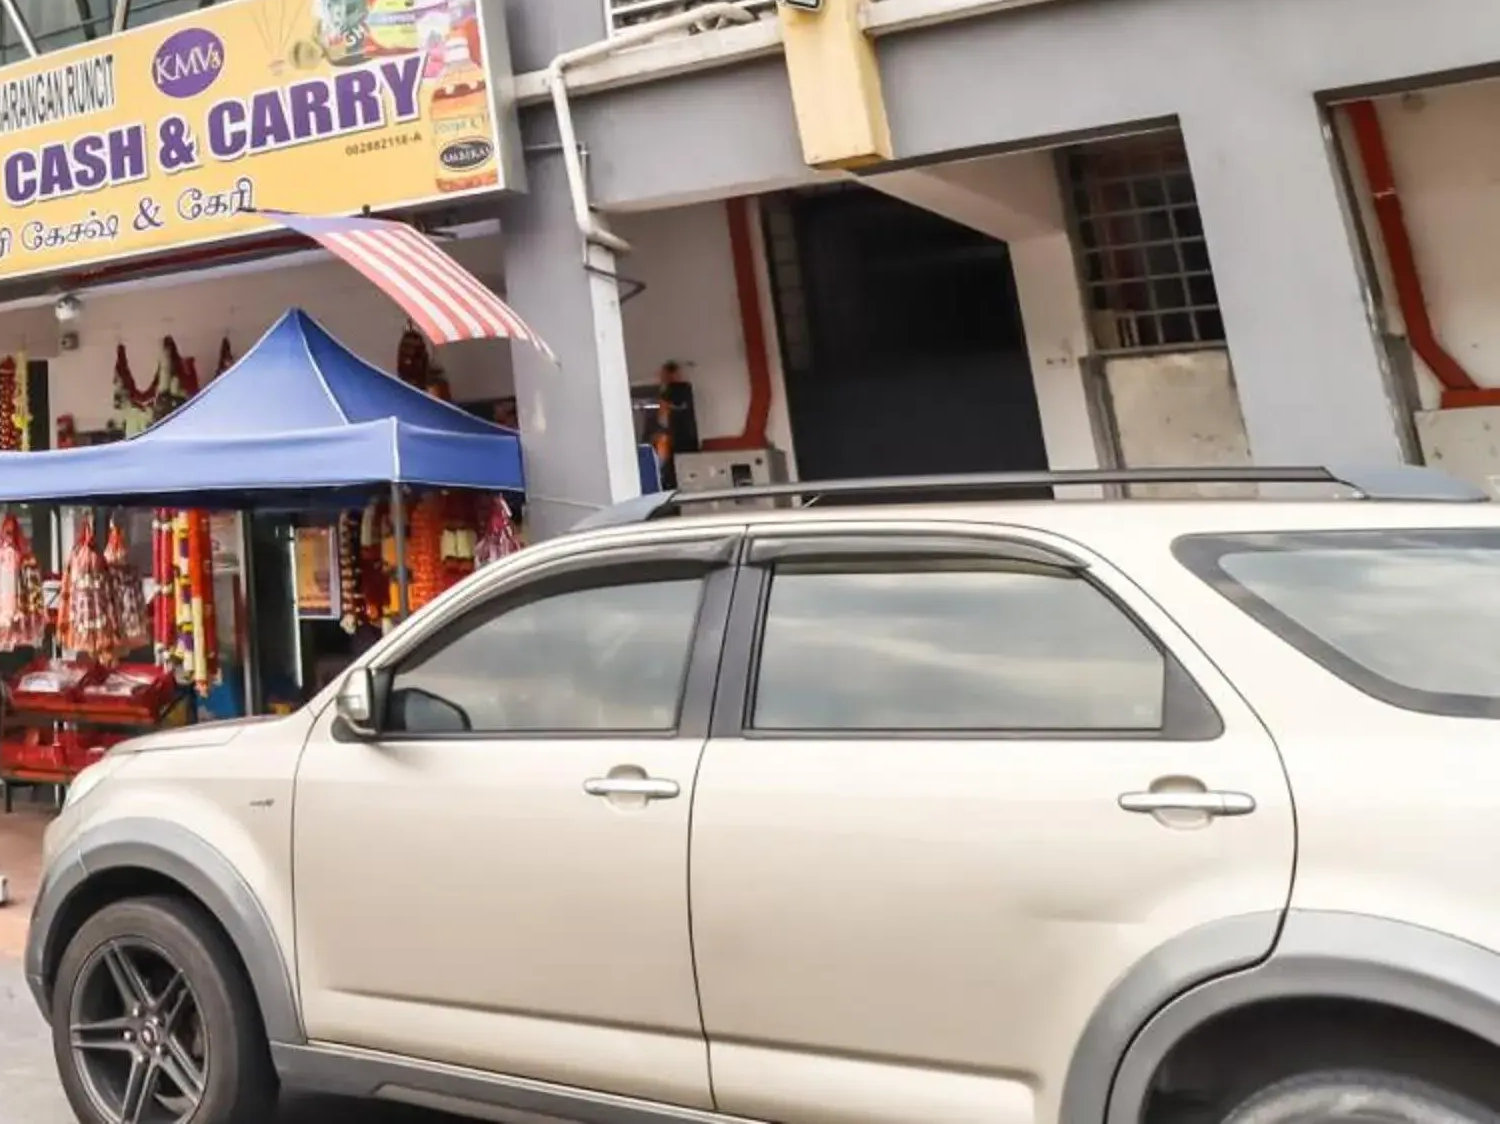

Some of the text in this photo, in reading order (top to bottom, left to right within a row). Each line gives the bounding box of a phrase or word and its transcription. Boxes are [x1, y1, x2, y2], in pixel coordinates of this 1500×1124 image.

[67, 55, 115, 113] RUNCIT
[4, 125, 144, 202] CASH
[159, 117, 196, 169] &
[207, 57, 421, 155] CARRY
[132, 196, 164, 232] &
